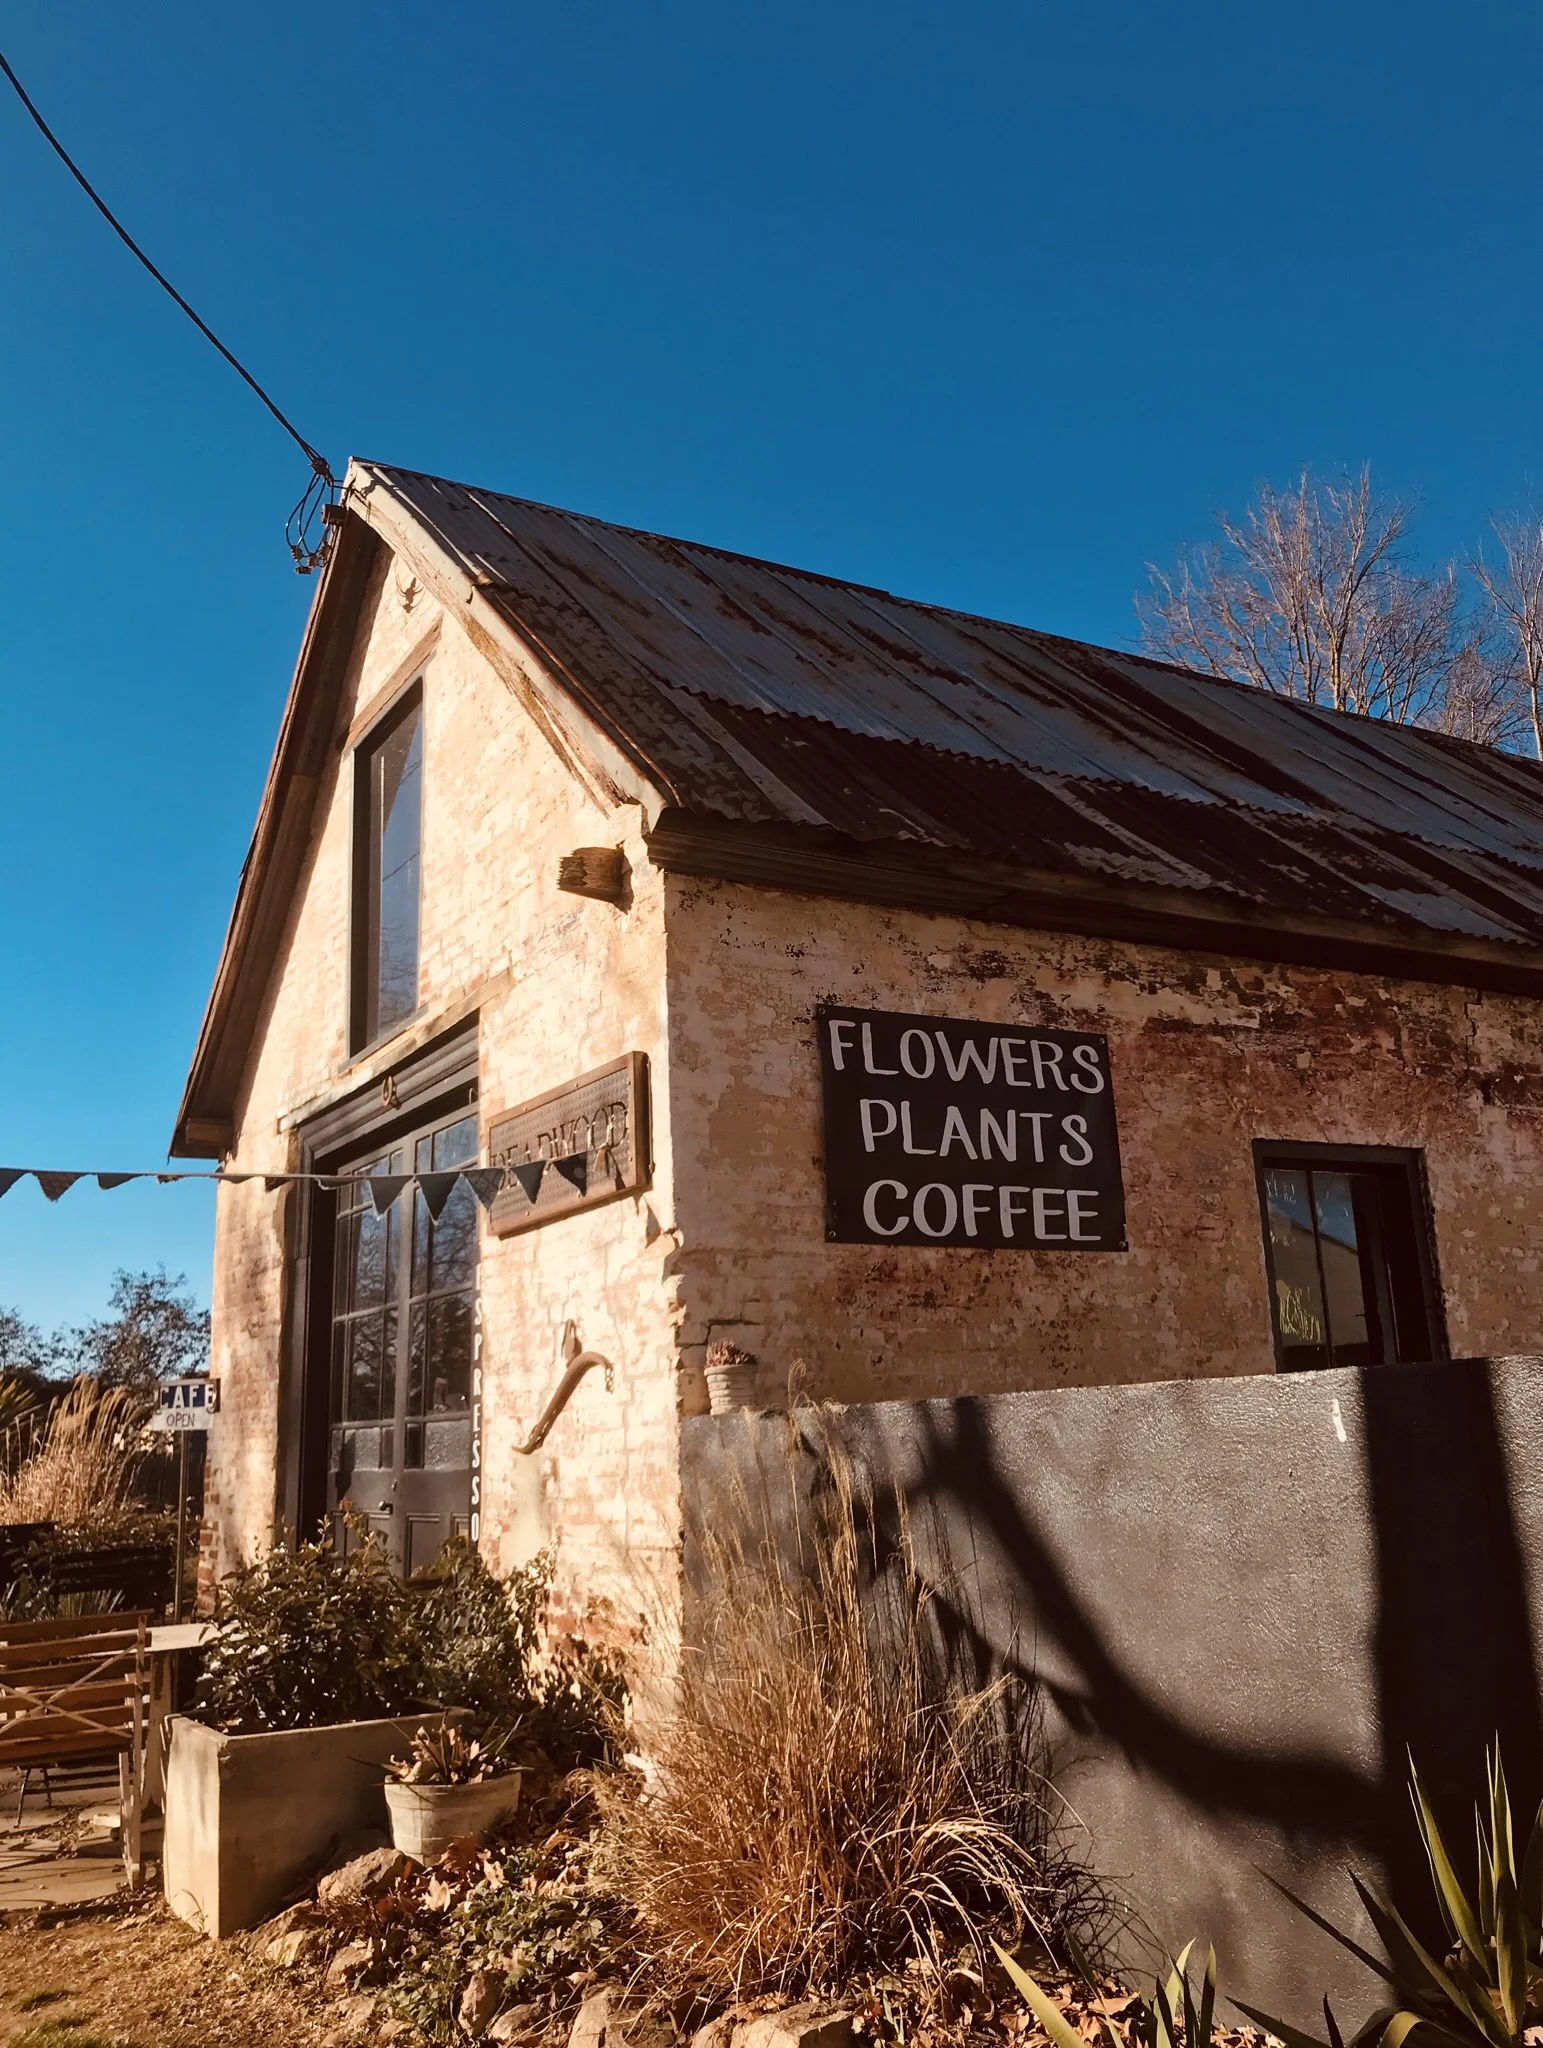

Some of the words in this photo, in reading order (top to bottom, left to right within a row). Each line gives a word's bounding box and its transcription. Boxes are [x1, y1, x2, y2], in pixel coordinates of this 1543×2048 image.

[828, 1020, 1105, 1093] FLOWERS
[860, 1099, 1094, 1166] PLANTS
[863, 1180, 1101, 1241] COFFEE
[160, 1383, 214, 1410] CAFE
[166, 1413, 195, 1427] OPEN
